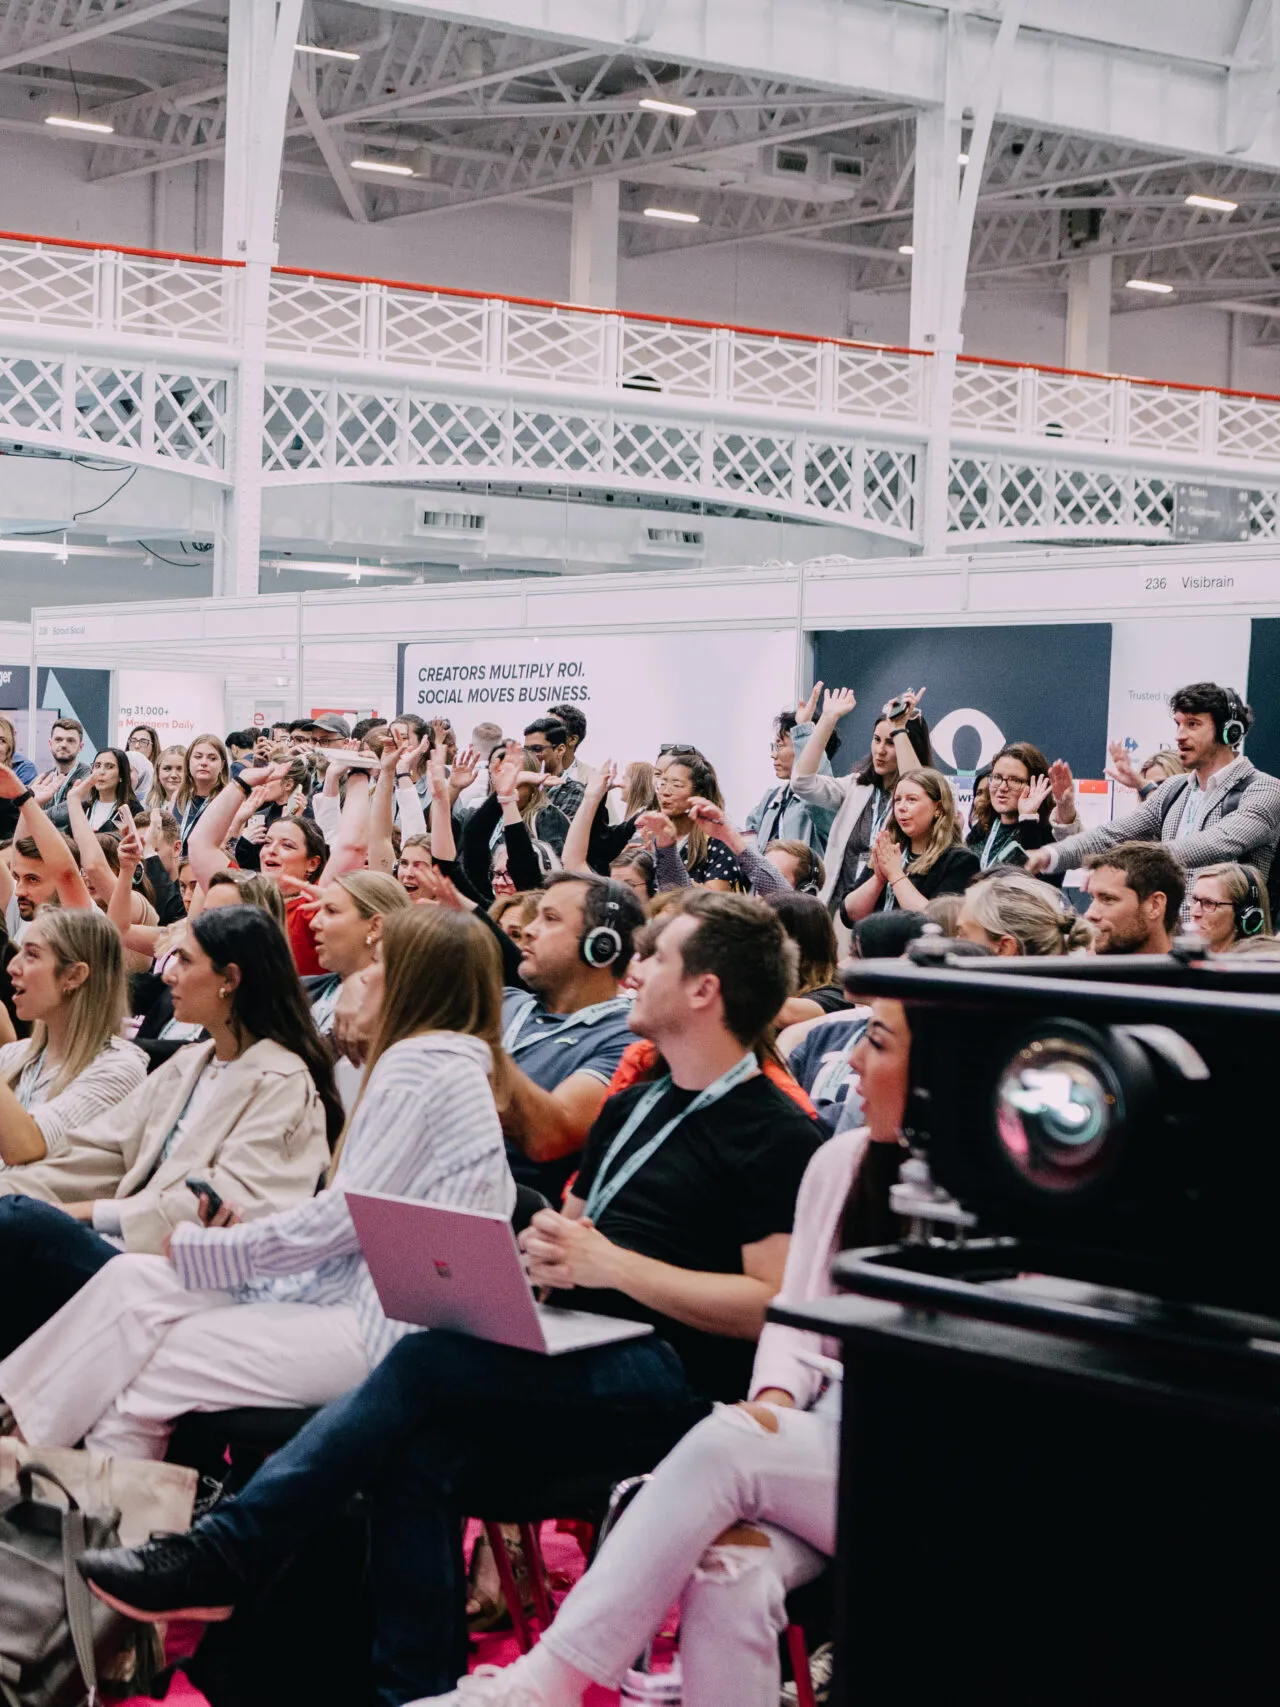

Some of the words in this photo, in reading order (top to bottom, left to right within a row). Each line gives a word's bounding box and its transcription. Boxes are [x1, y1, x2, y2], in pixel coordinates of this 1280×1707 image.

[1145, 578, 1167, 590] 236
[1181, 575, 1234, 589] Visibrain
[418, 665, 486, 682] CREATORS
[489, 662, 554, 680] MULTIPLY
[557, 661, 585, 678] ROI.
[417, 688, 463, 704] SOCIAL
[467, 687, 515, 703] MOVES
[519, 685, 591, 702] BUSINESS.
[1128, 689, 1161, 701] Trusted
[134, 705, 169, 716] 31,000+
[172, 720, 194, 731] Daily
